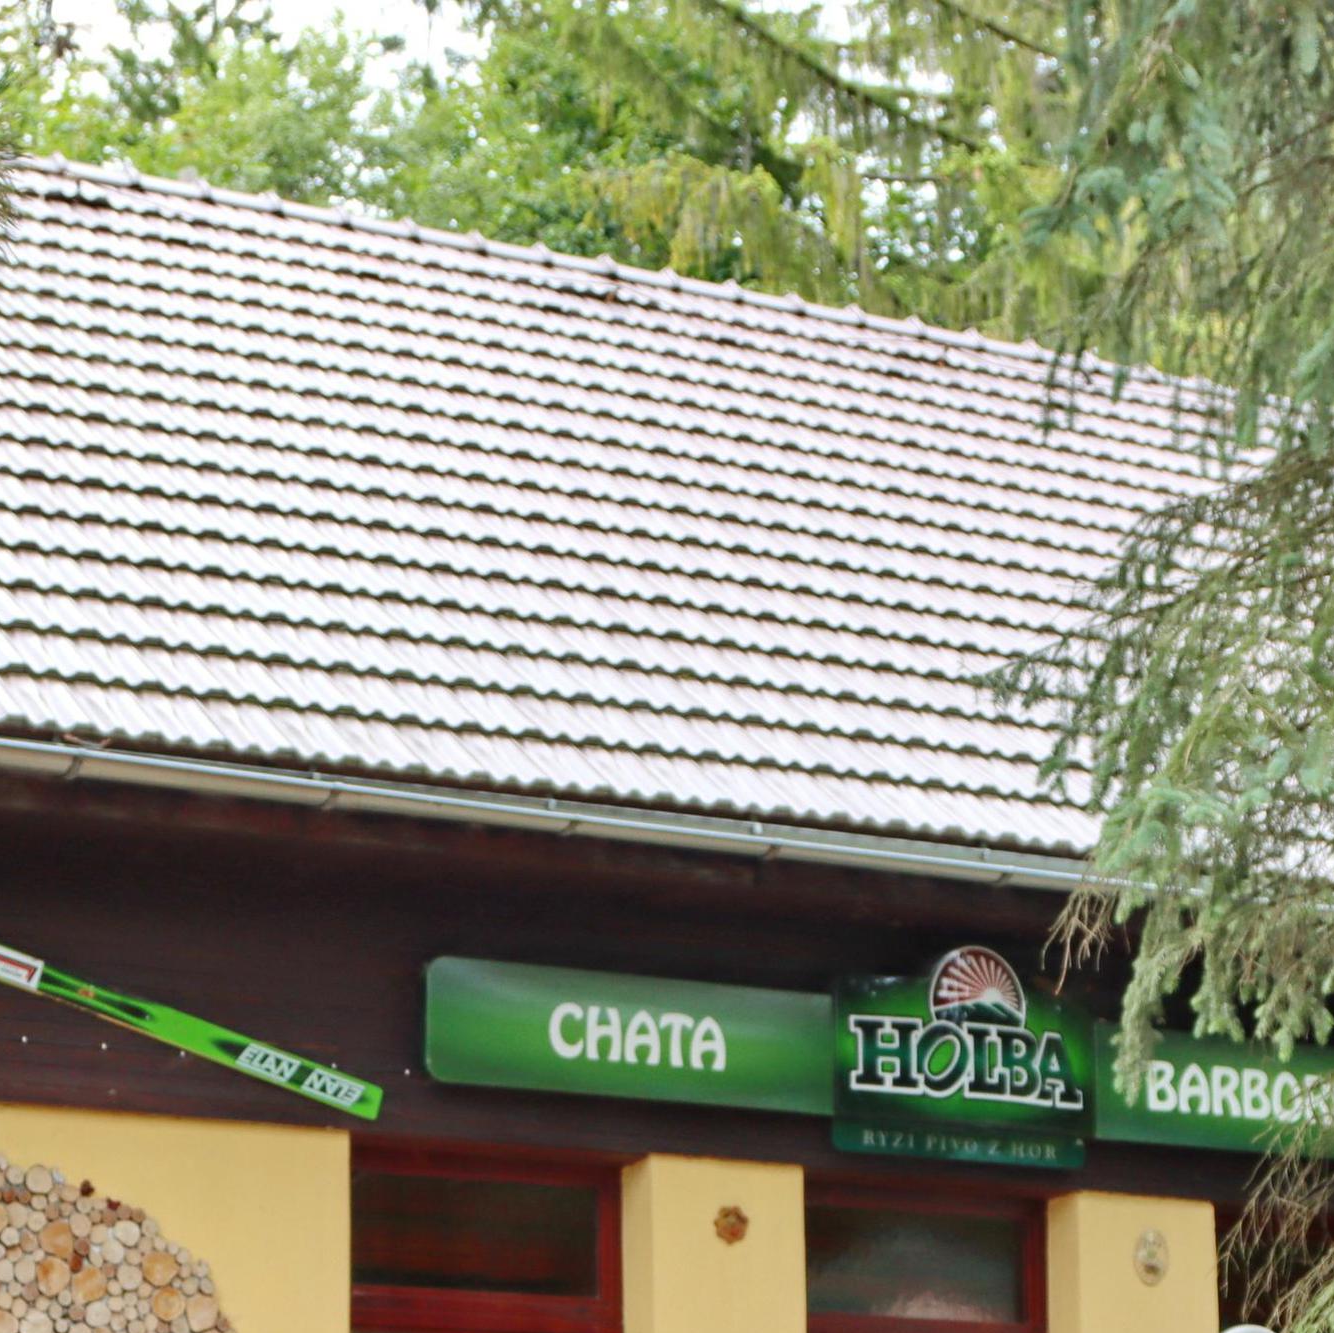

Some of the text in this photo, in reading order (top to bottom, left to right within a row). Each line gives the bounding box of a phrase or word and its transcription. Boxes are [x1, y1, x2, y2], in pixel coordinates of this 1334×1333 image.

[235, 1043, 301, 1082] ELAN
[549, 1002, 727, 1071] CHATA
[849, 1014, 1083, 1110] HOLBA
[301, 1068, 365, 1106] ELAN
